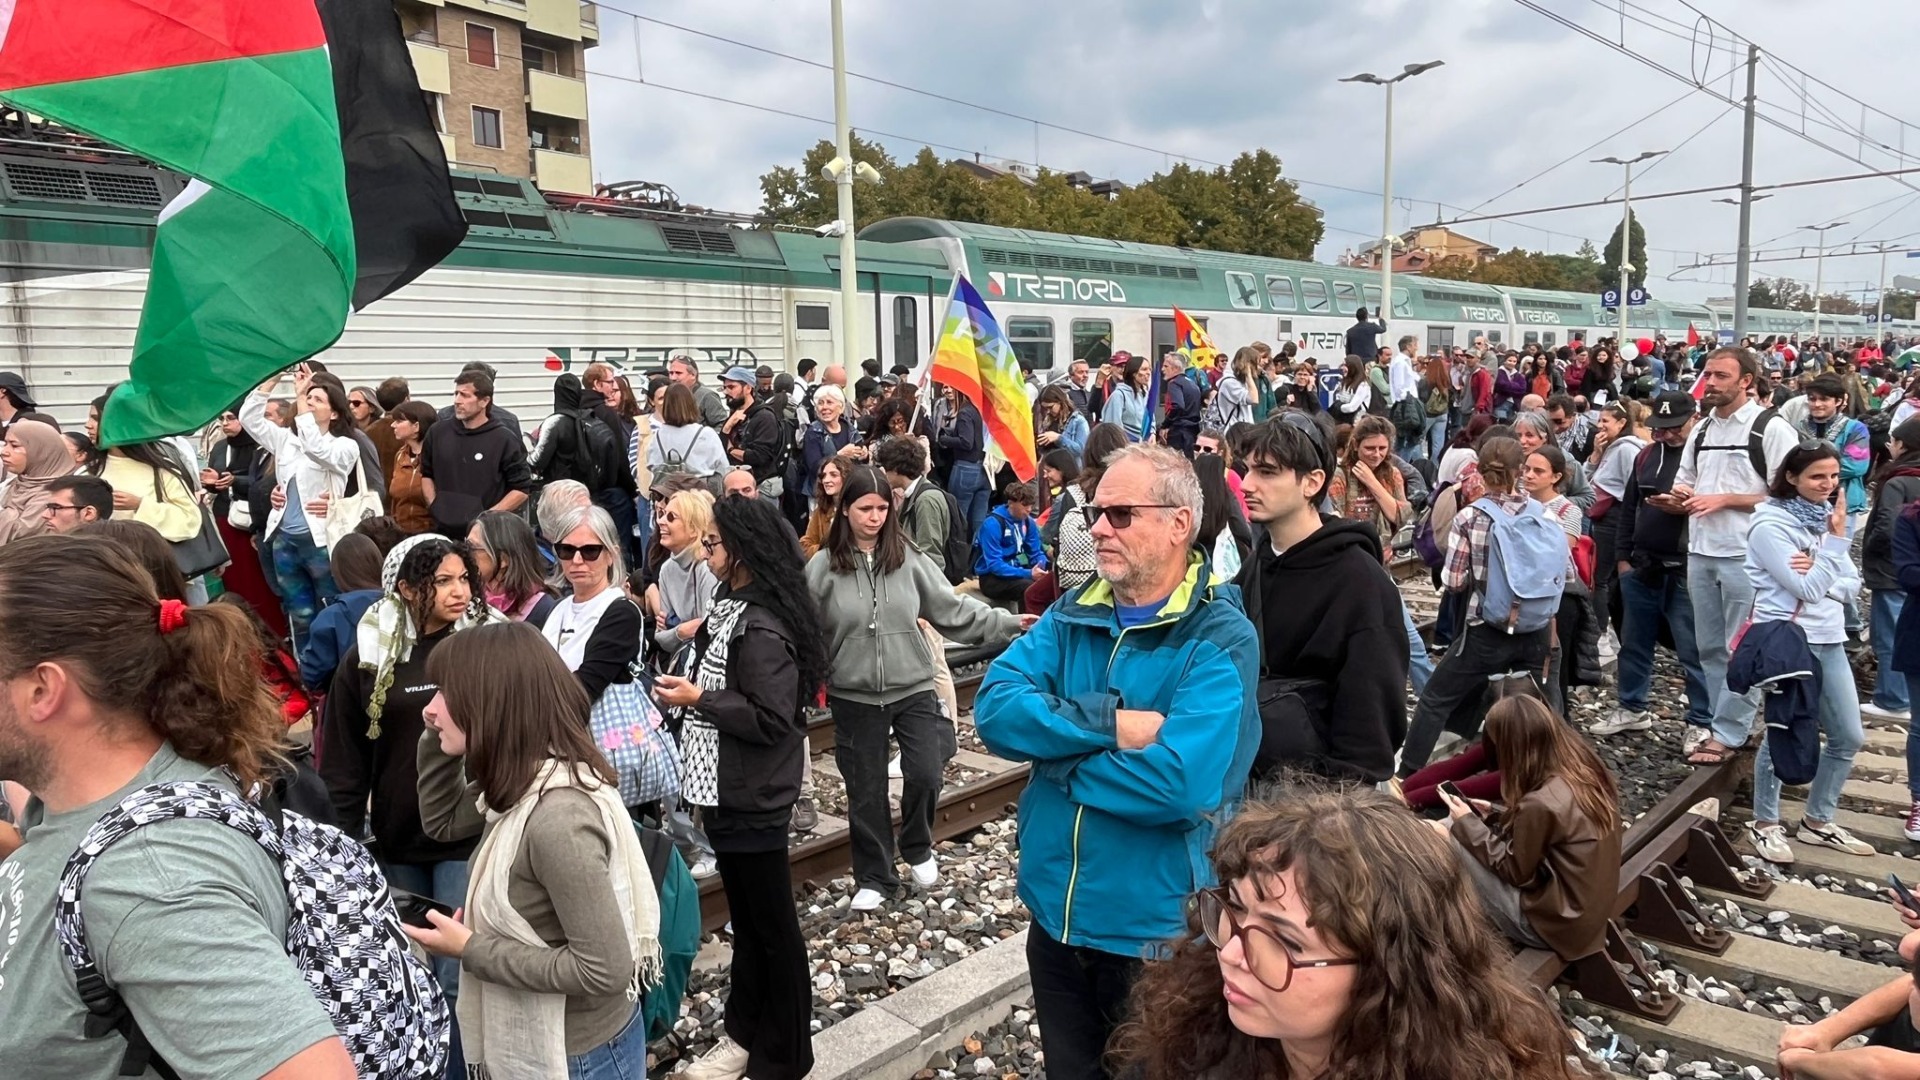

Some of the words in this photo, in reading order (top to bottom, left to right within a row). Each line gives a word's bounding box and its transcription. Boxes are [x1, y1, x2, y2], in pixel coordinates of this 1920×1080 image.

[1007, 273, 1127, 302] TRENORD
[1466, 306, 1505, 322] TRENORD
[1523, 310, 1561, 323] TRENORD
[1309, 332, 1347, 350] TREN
[952, 317, 1026, 391] PAC
[1659, 401, 1672, 415] A
